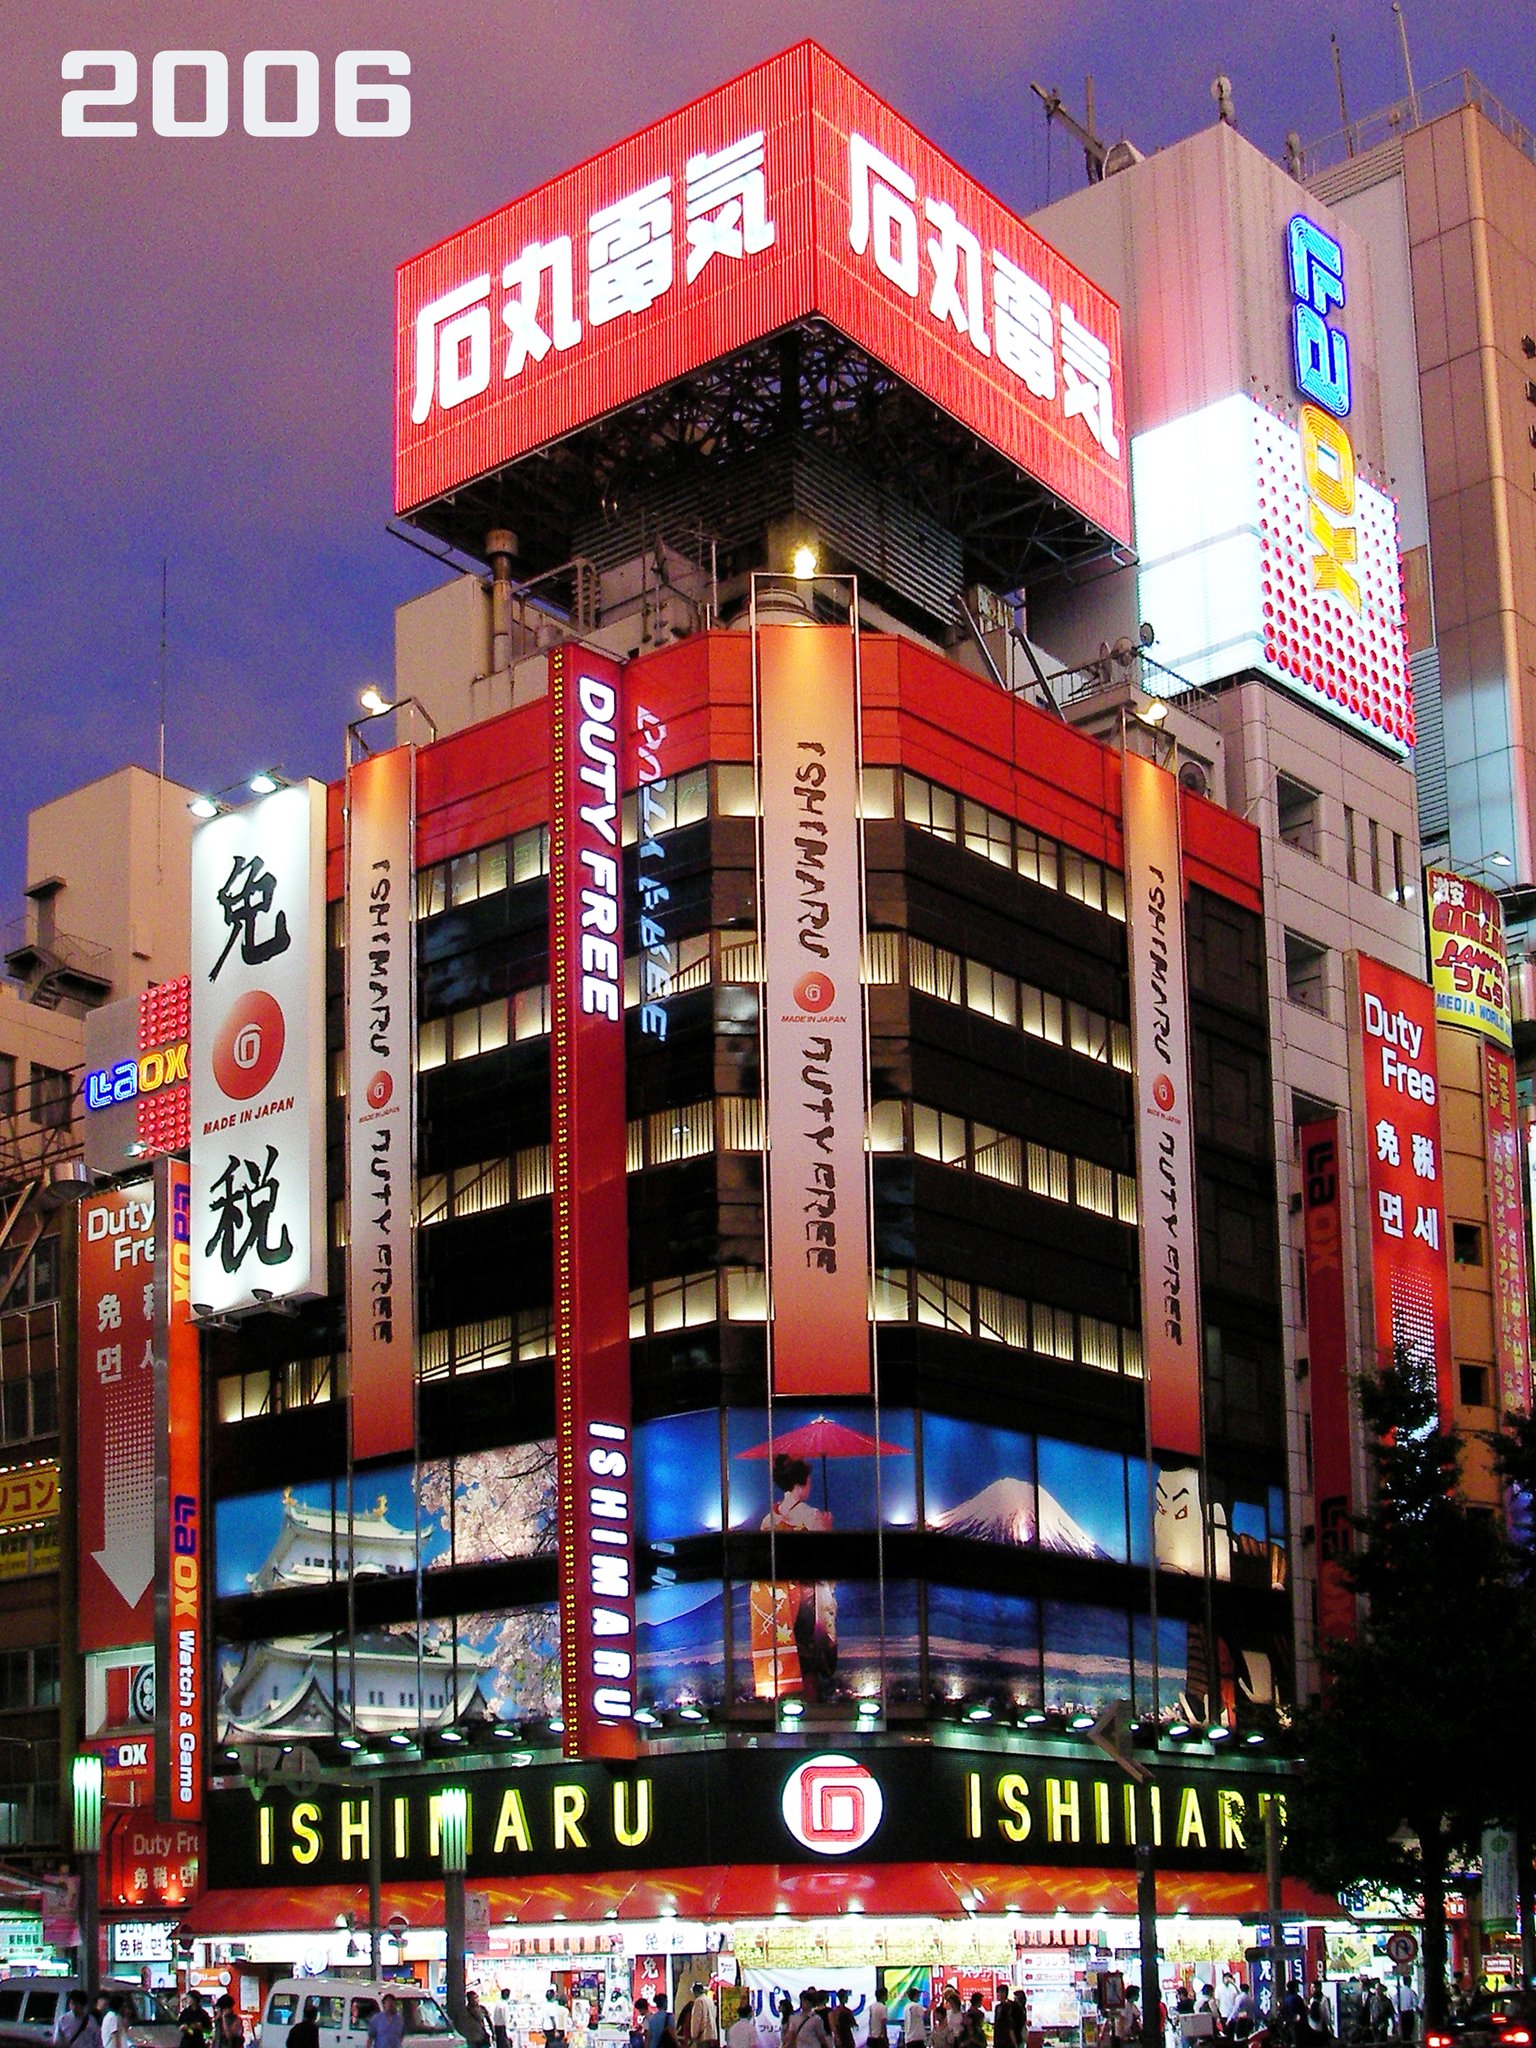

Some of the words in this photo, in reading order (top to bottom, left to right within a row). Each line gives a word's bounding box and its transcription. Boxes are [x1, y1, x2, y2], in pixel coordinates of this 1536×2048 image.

[411, 129, 776, 425] 石丸電気
[849, 132, 1120, 461] 石丸電気
[578, 675, 617, 846] DUTY
[794, 742, 830, 960] ISHIMARU
[208, 855, 291, 983] 免
[581, 849, 620, 1022] FREE
[368, 859, 391, 1057] ISHIMARU
[1148, 866, 1171, 1065] ISHIMARU
[1364, 992, 1422, 1059] Duty
[1437, 993, 1475, 1017] MEDIA
[1381, 1046, 1436, 1105] Free
[203, 1114, 236, 1135] MADE
[240, 1109, 253, 1124] IN
[255, 1096, 295, 1119] JAPAN
[88, 1199, 154, 1242] Duty
[204, 1144, 294, 1275] 税
[1378, 1190, 1439, 1250] 면세
[113, 1235, 155, 1271] Fre
[587, 1422, 633, 1722] ISHIMARU
[179, 1630, 195, 1707] Watch
[95, 1744, 147, 1767] aOX
[179, 1712, 193, 1728] &
[179, 1733, 195, 1803] Game
[133, 1833, 171, 1857] Duty
